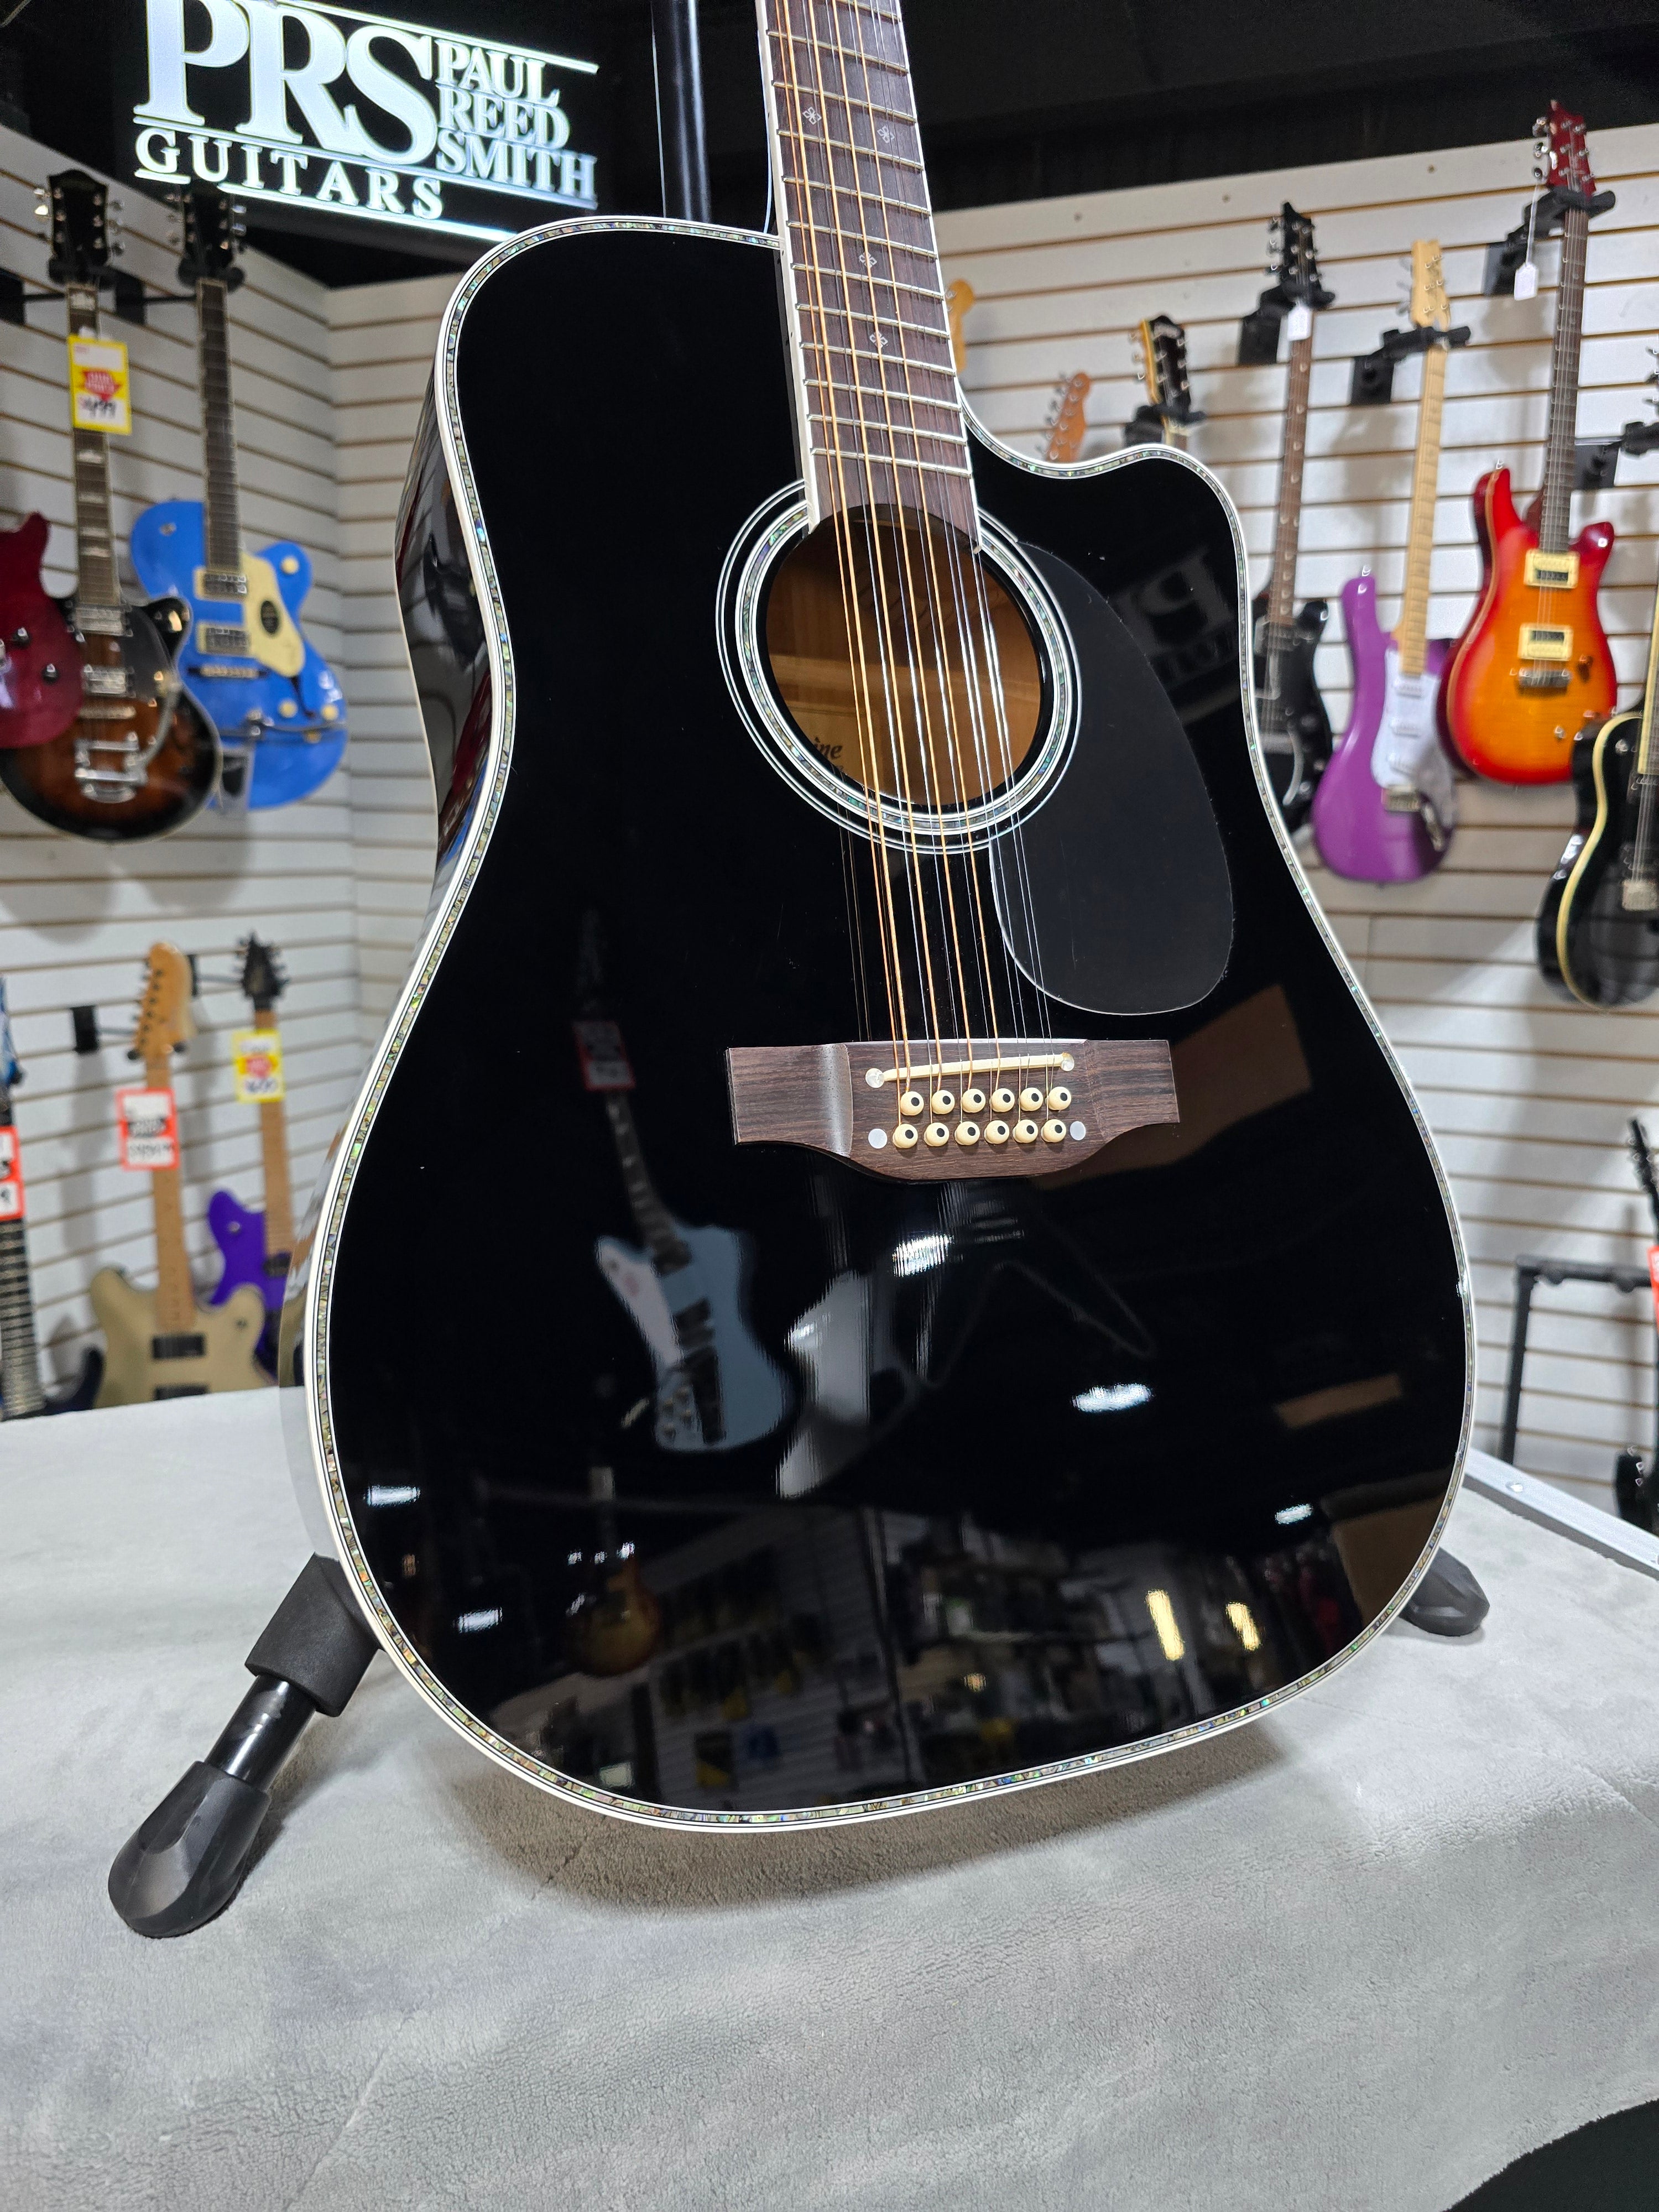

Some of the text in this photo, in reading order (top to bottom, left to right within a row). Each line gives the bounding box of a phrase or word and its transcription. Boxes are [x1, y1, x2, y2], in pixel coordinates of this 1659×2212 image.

[133, 0, 436, 165] PRS
[434, 38, 560, 107] PAUL
[435, 84, 570, 151] REED
[135, 128, 443, 220] GUITARS
[436, 129, 598, 201] SMITH
